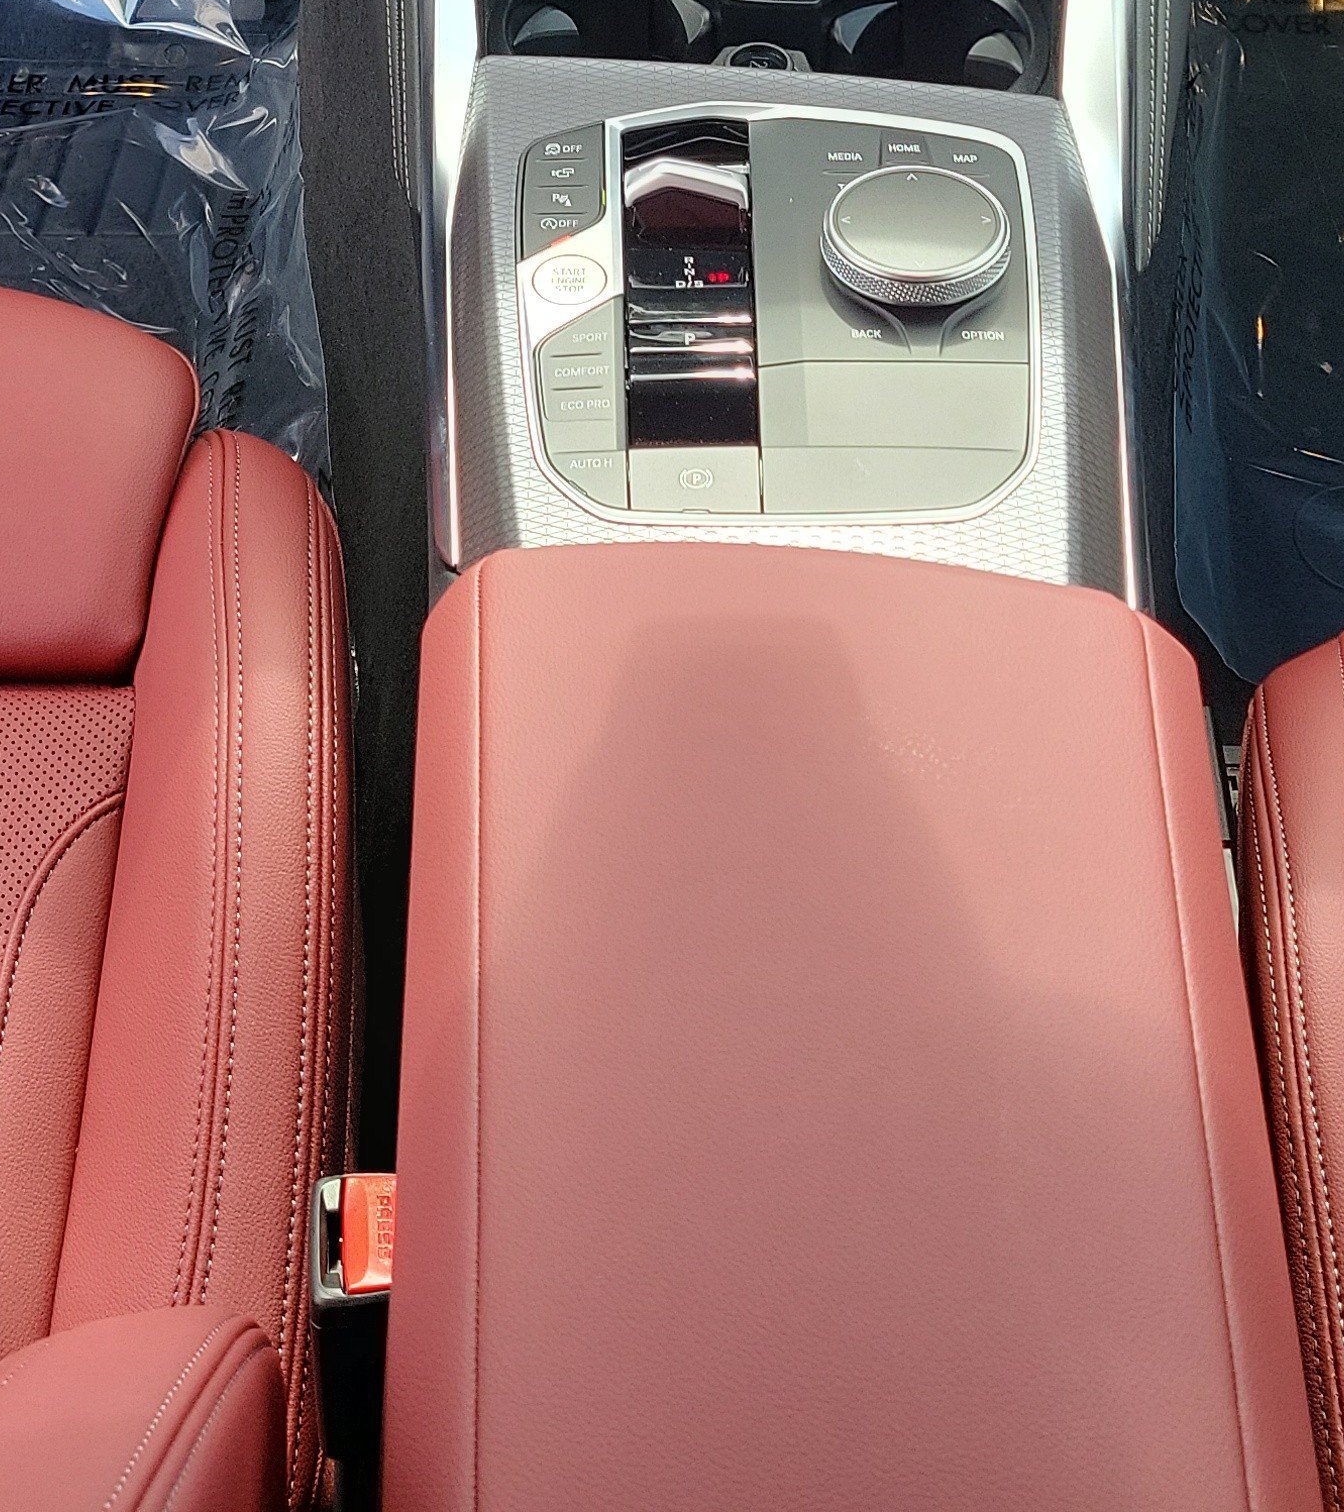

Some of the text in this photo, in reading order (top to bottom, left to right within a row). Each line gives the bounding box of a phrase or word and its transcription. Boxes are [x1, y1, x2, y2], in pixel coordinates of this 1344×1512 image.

[563, 144, 582, 154] OFF
[827, 143, 977, 163] MEDIA HOME MAP
[558, 219, 578, 228] OFF
[553, 267, 586, 276] START
[572, 332, 608, 343] SPORT
[684, 333, 696, 345] P
[851, 329, 1004, 342] BACK OPTION
[554, 366, 609, 377] COMFORT
[560, 399, 611, 411] ECO PRO
[570, 458, 612, 469] AUTO H
